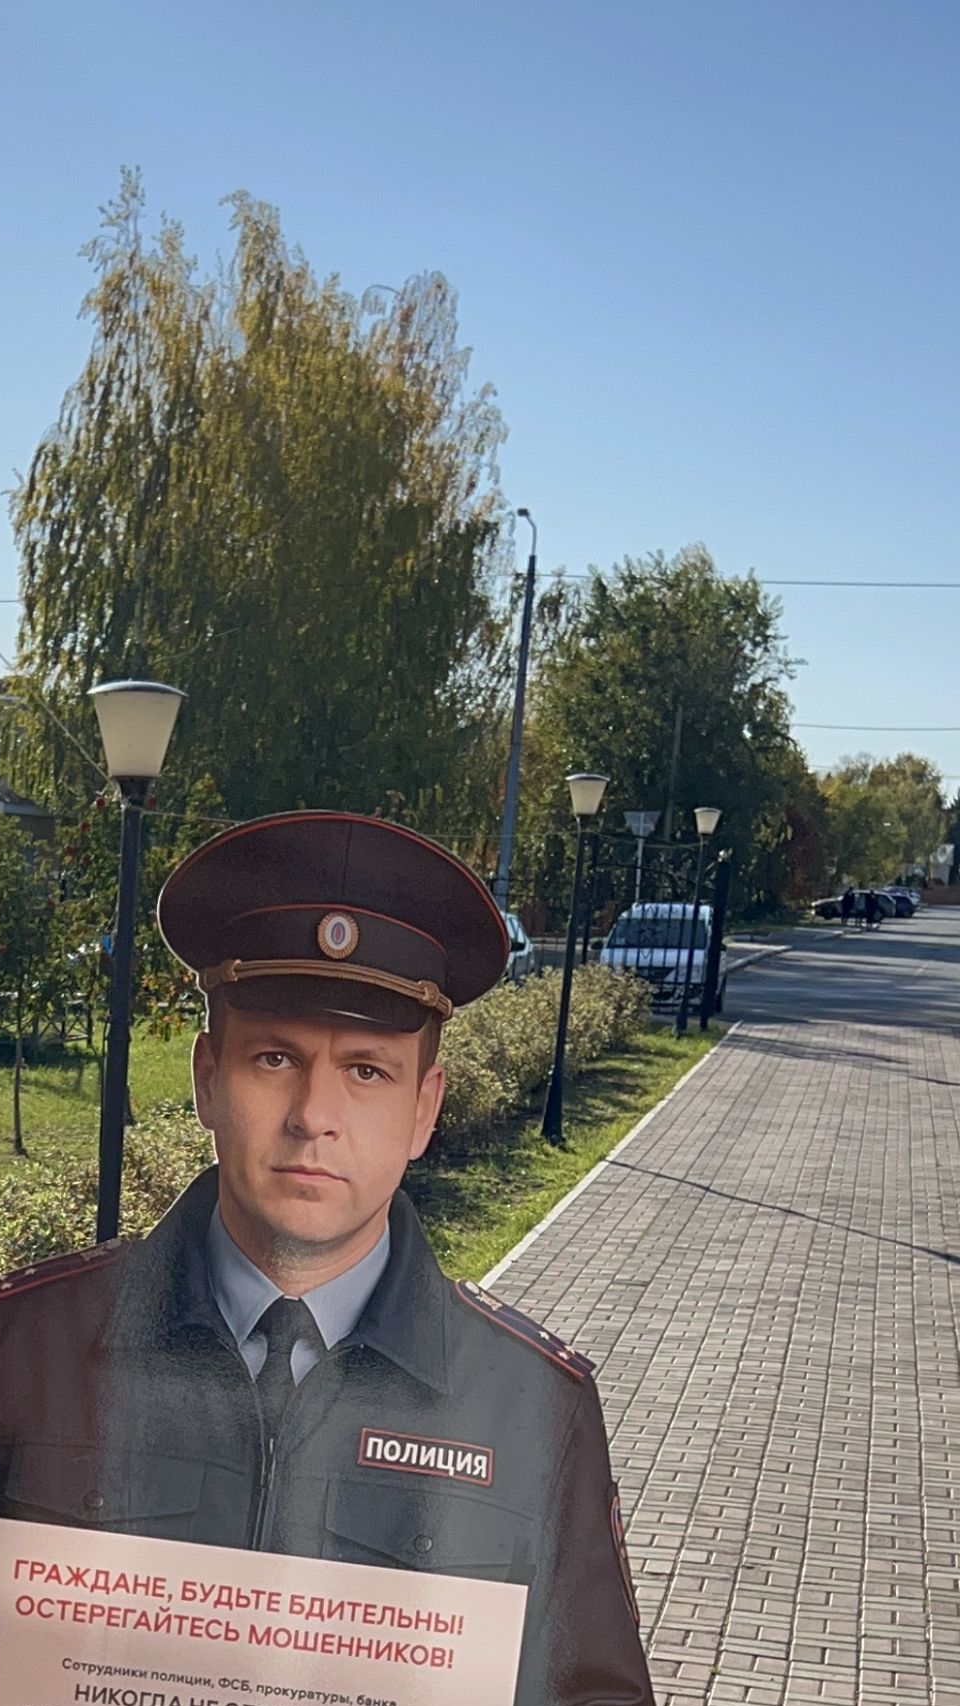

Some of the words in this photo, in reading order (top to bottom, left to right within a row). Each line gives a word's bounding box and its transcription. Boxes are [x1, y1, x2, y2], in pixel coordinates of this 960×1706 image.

[365, 1436, 488, 1477] ПОЛИЦИЯ
[14, 1559, 173, 1603] ГРАЖДАНЕ,
[180, 1580, 282, 1613] БУДЬТЕ
[288, 1594, 464, 1636] БДИТЕЛЬНЫ!
[15, 1595, 240, 1642] ОСТЕРЕГАЙТЕСЬ
[248, 1624, 454, 1669] МОШЕННИКОВ!
[62, 1657, 148, 1679] Сотрудники
[150, 1671, 215, 1689] полиции,
[217, 1677, 253, 1694] ФСБ,
[255, 1684, 353, 1706] прокуратуры,
